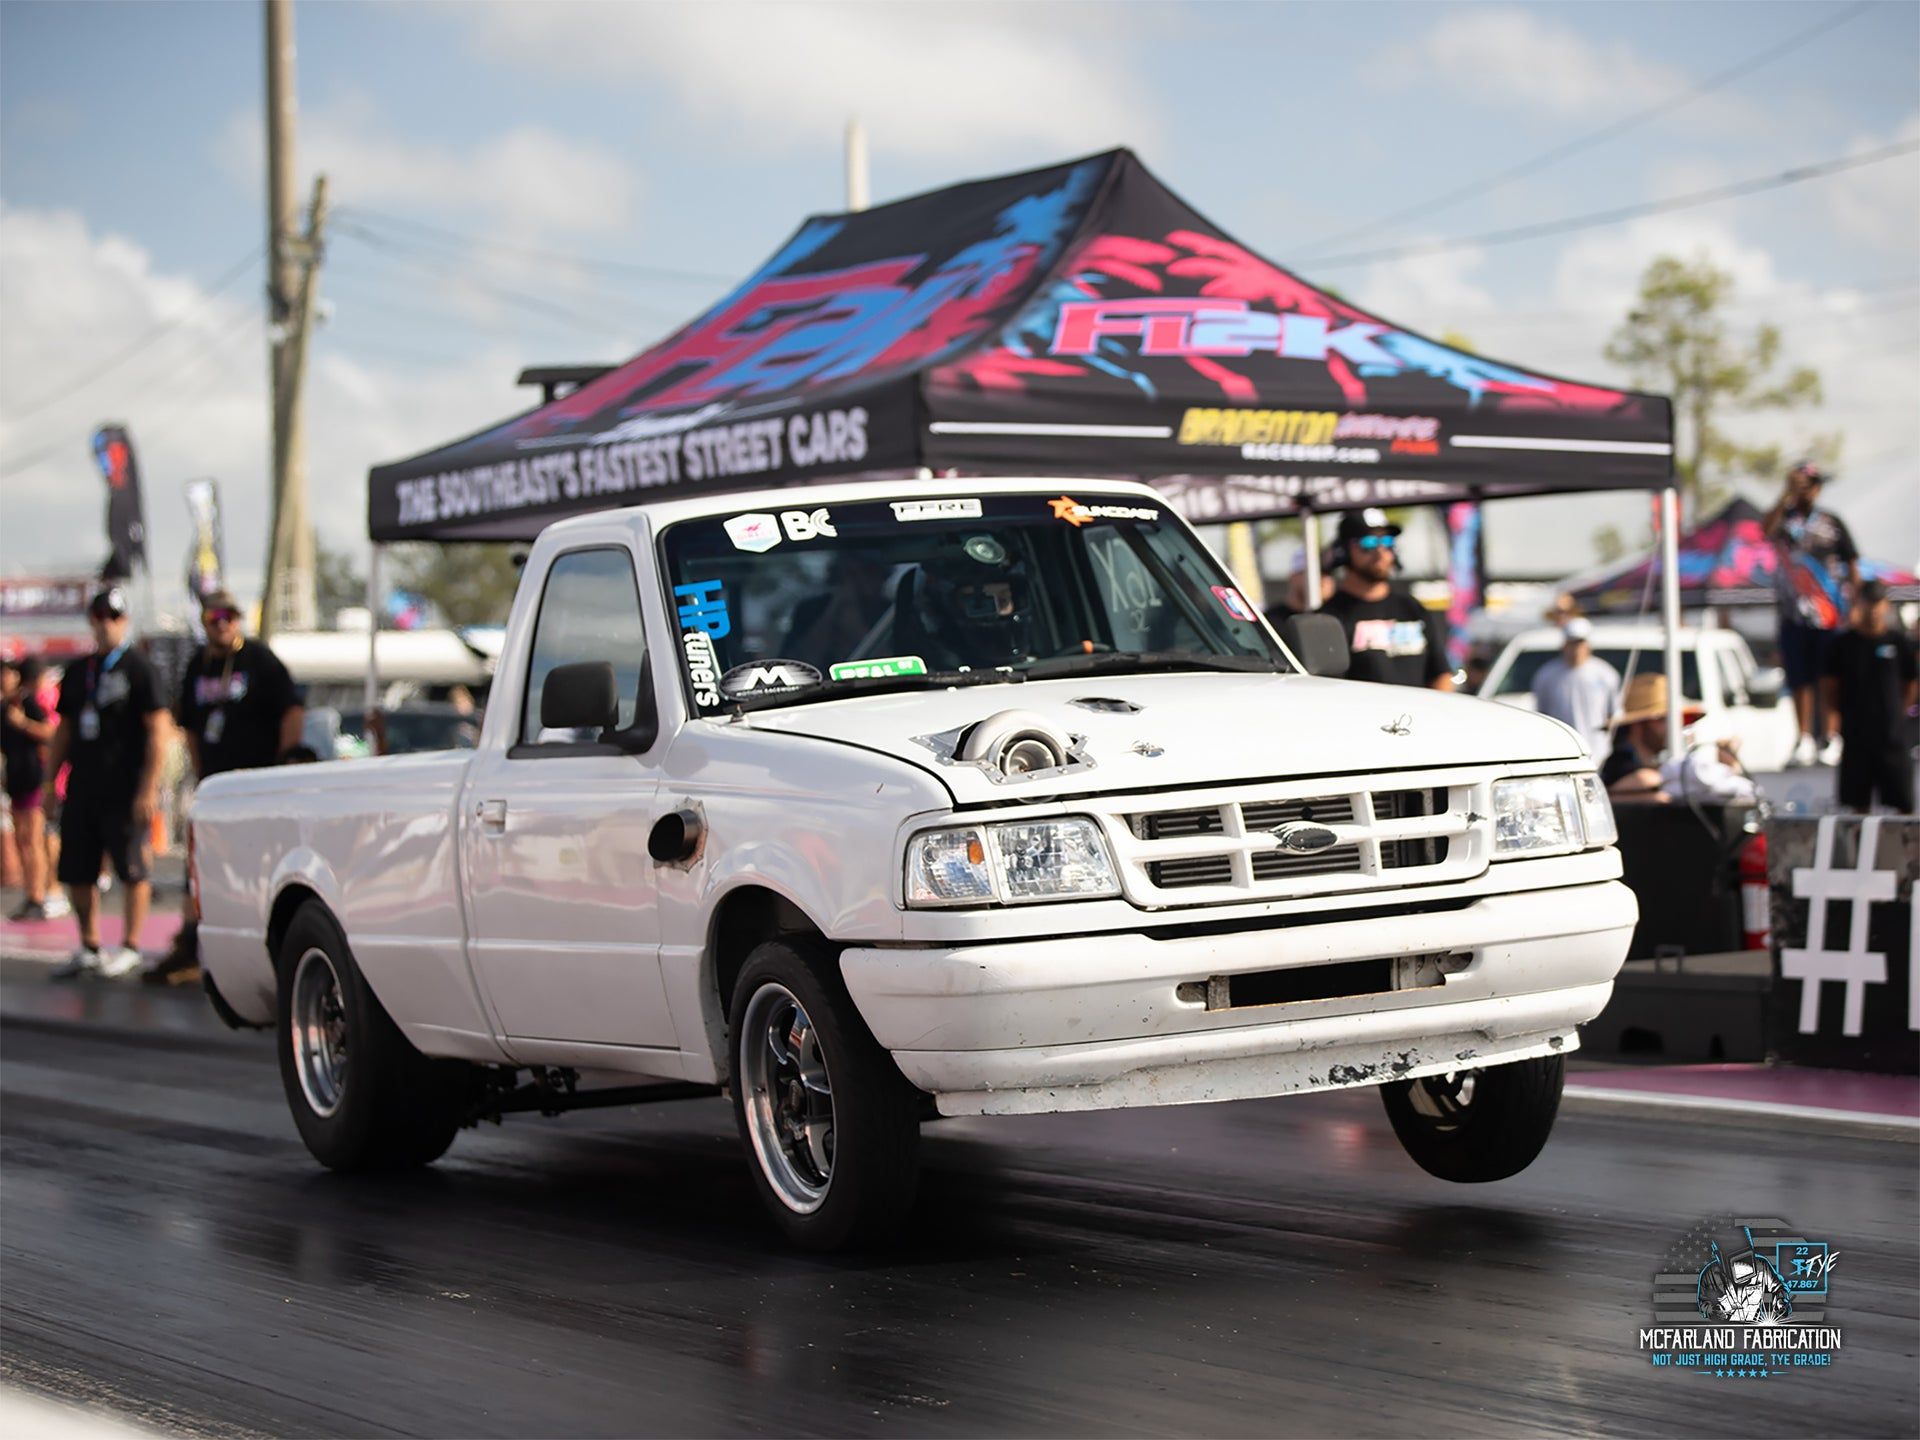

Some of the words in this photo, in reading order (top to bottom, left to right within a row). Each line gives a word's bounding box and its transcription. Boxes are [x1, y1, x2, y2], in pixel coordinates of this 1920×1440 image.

[396, 475, 437, 526] THE
[437, 451, 579, 519] SOUTHEAST'S
[578, 436, 681, 498] FASTEST
[683, 417, 785, 481] STREET
[788, 406, 869, 468] CARS
[674, 579, 731, 640] HP
